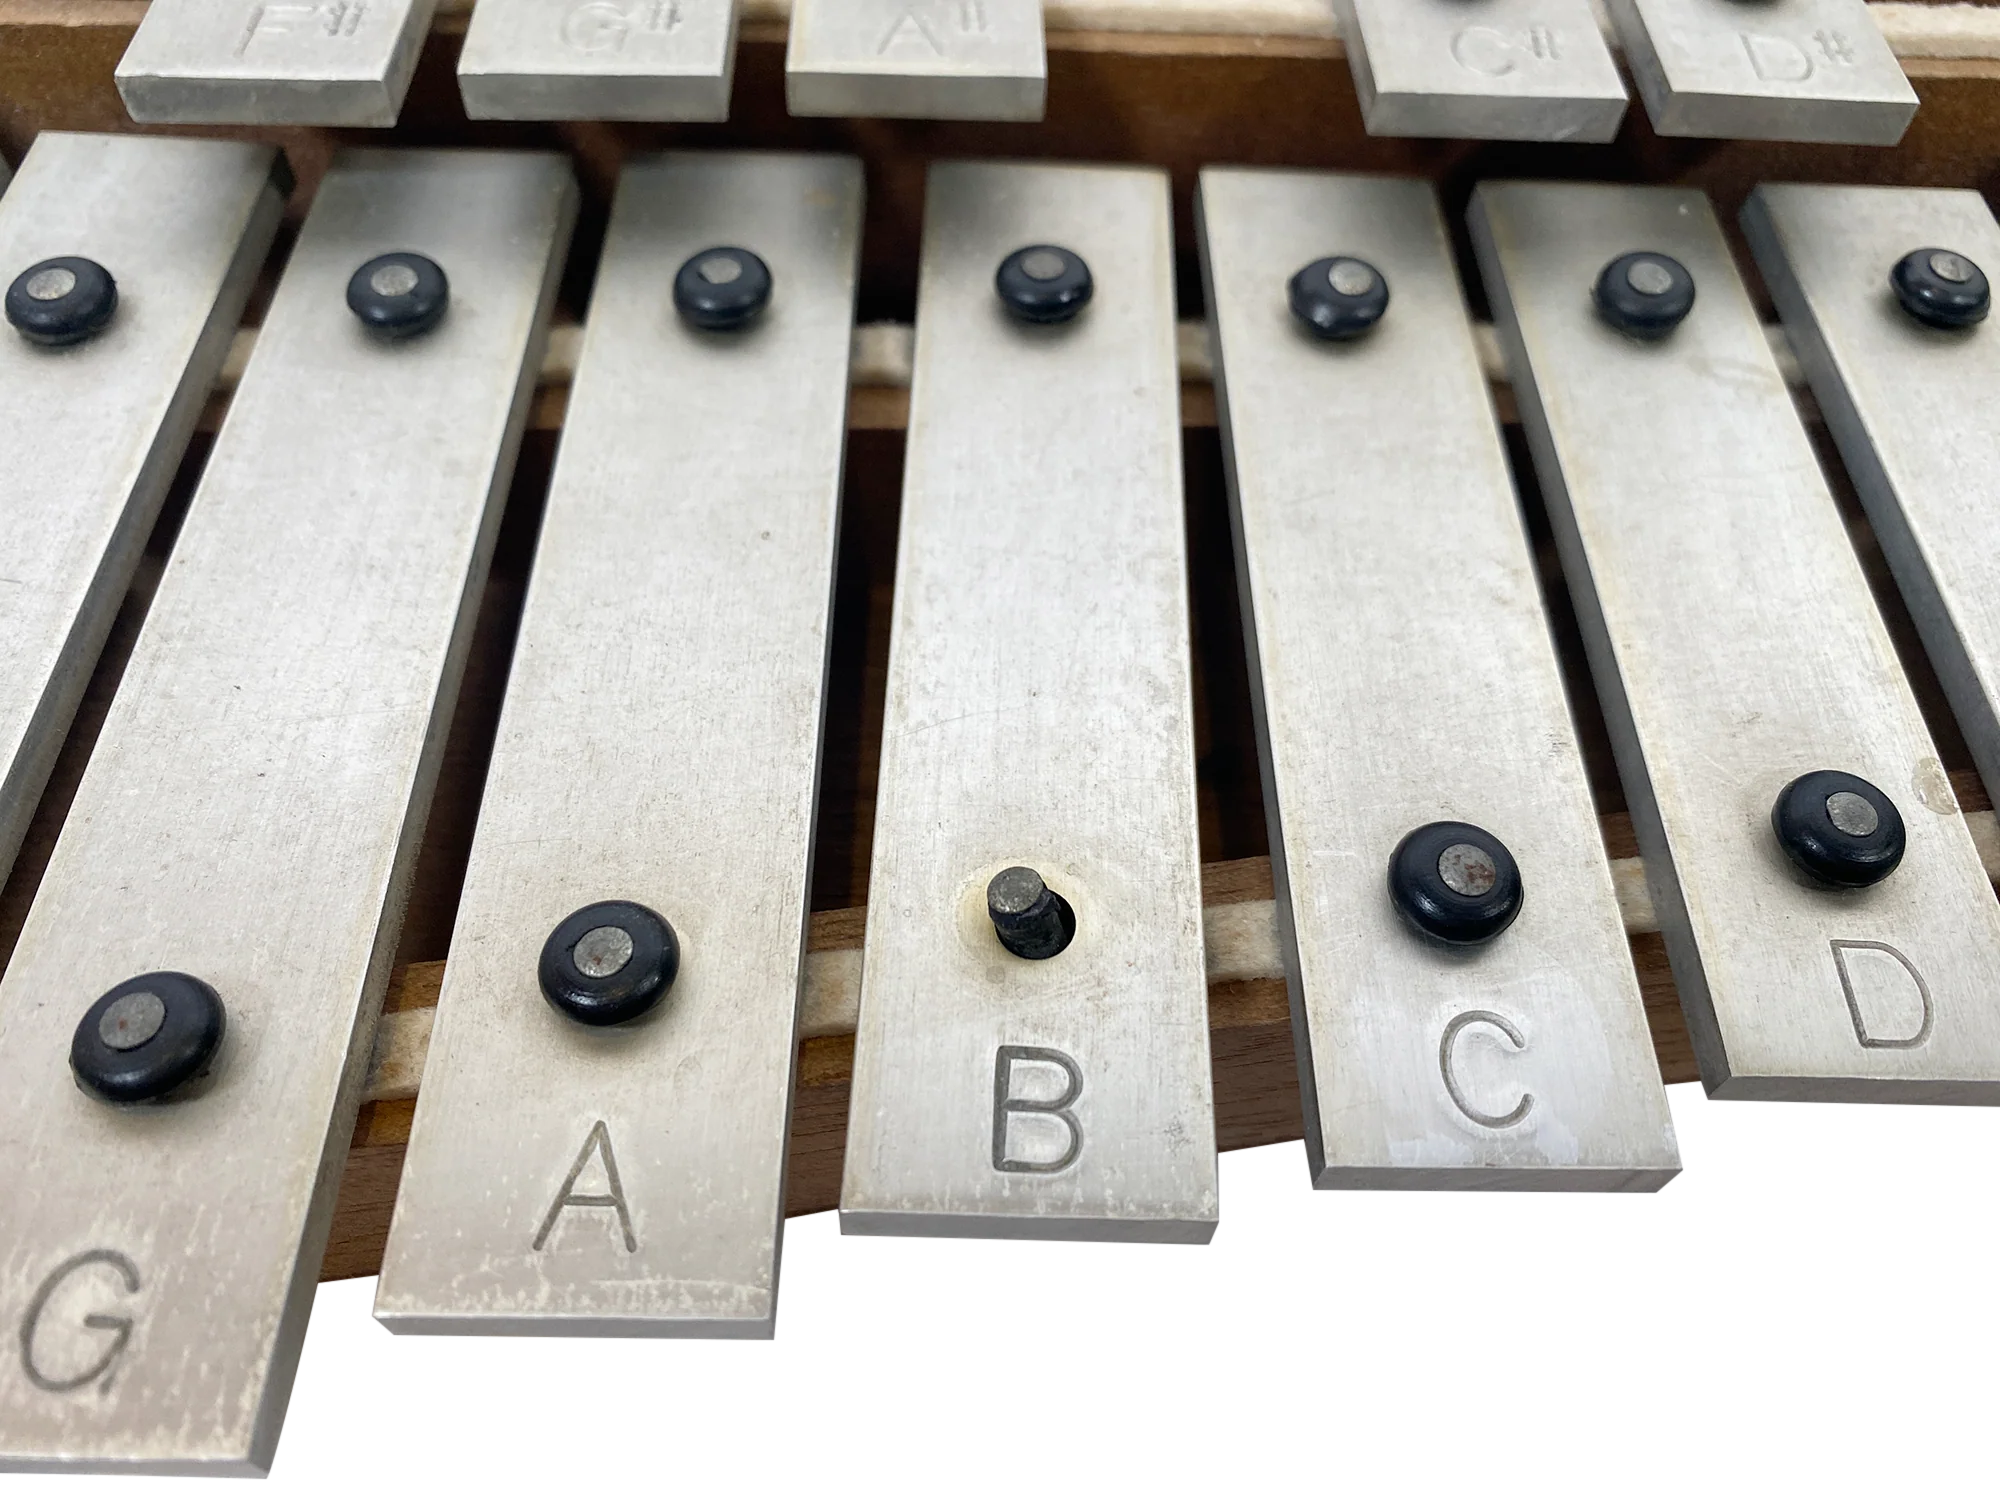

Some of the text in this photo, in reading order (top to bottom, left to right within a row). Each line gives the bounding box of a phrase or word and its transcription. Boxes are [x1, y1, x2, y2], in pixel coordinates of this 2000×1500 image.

[1829, 939, 1934, 1049] D
[992, 1044, 1085, 1174] B
[1438, 1009, 1535, 1129] C
[532, 1119, 637, 1253] A
[18, 1249, 140, 1396] G
